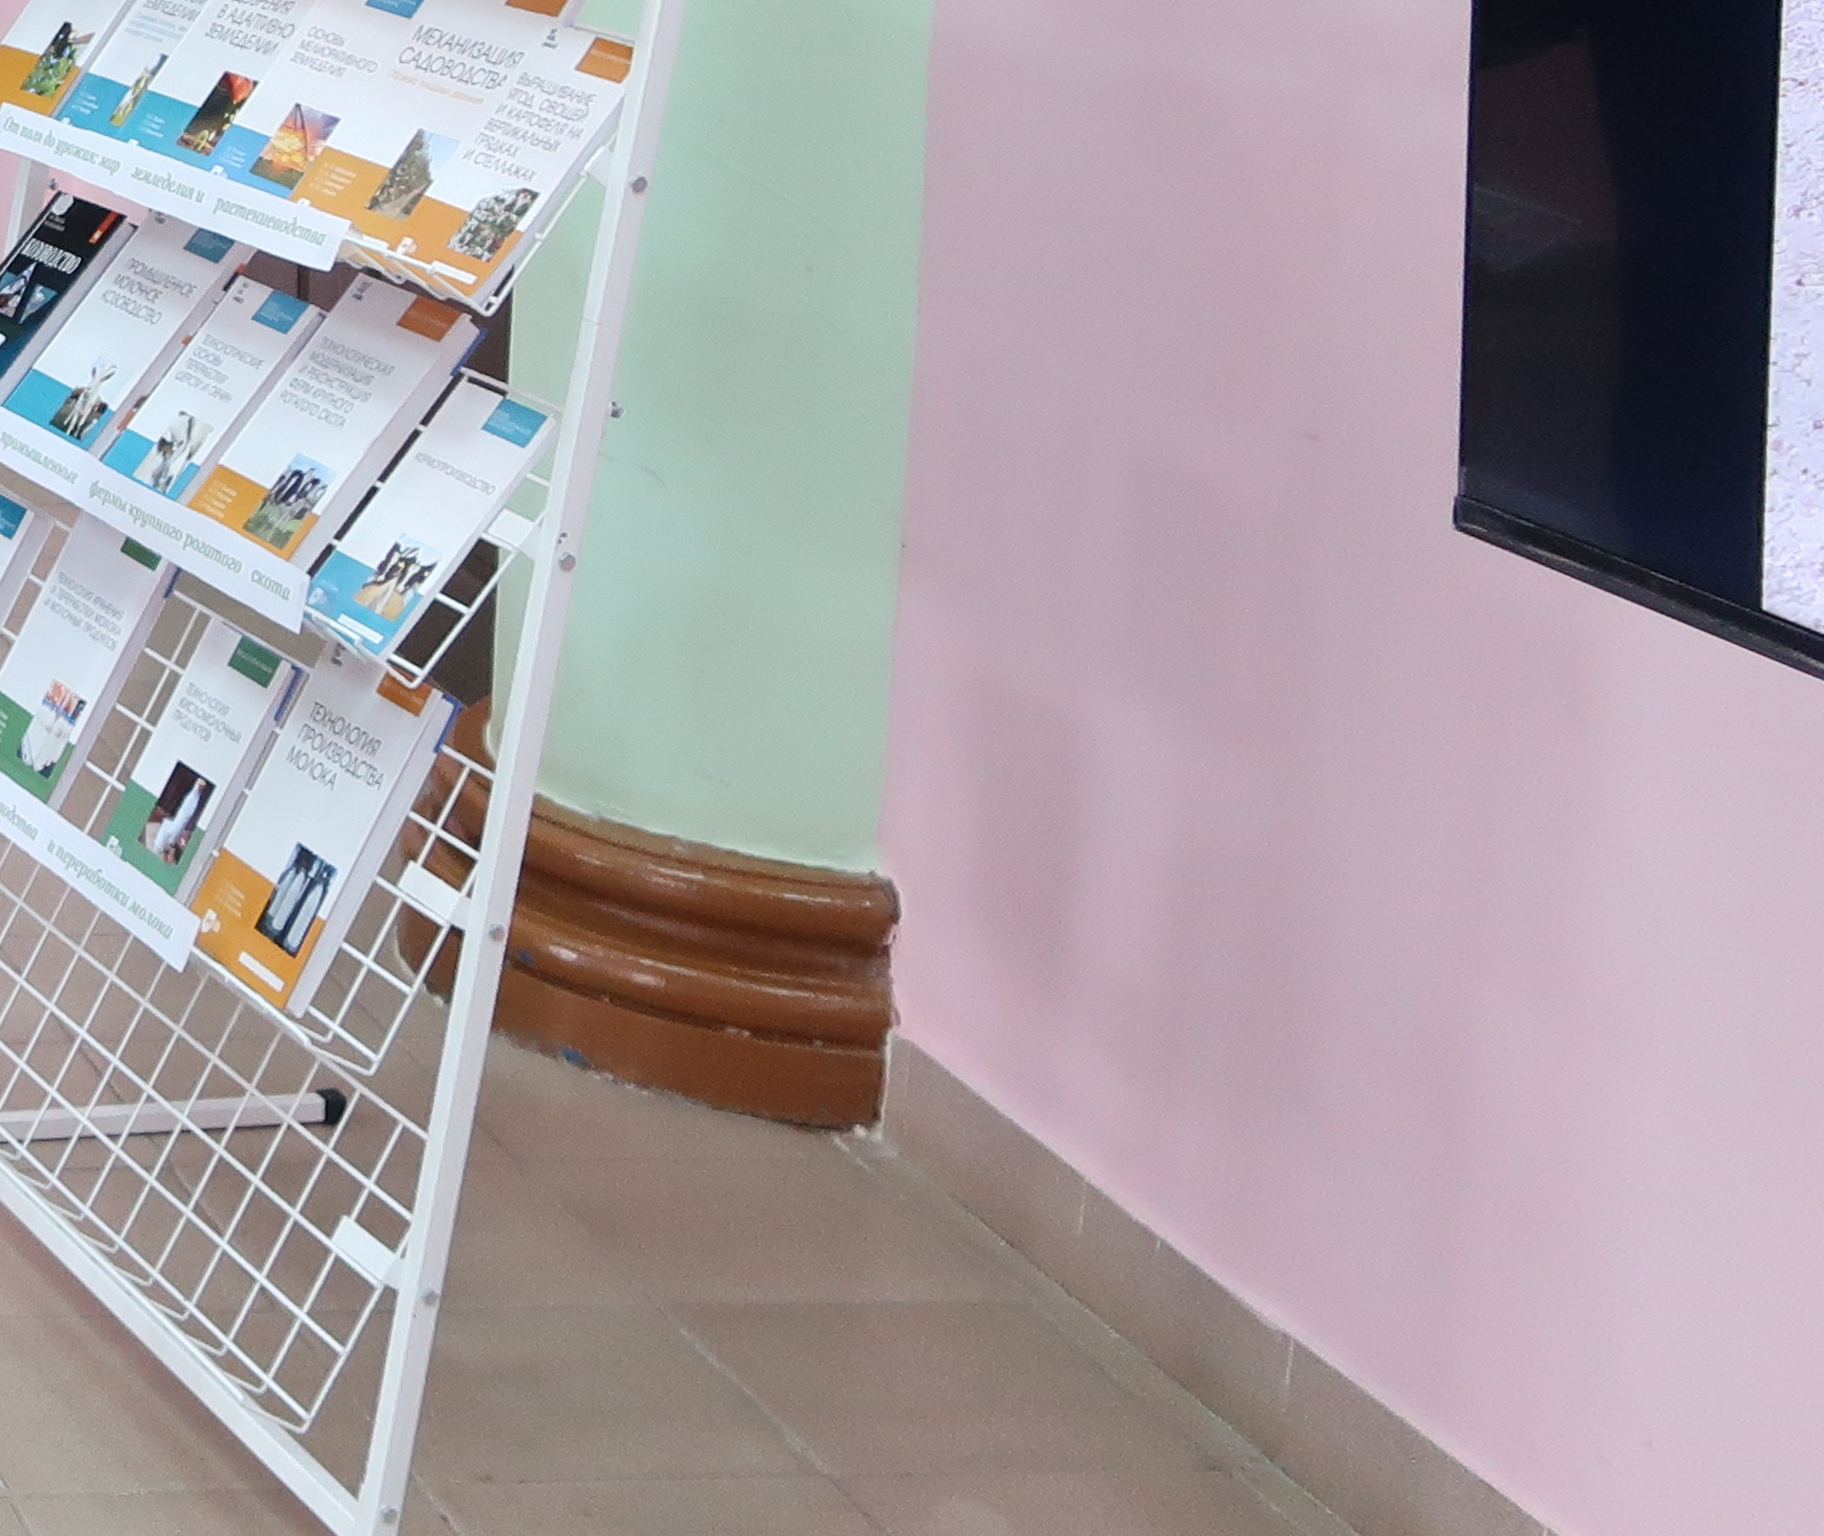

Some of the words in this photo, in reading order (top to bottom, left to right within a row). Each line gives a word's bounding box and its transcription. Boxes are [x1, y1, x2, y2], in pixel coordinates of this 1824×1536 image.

[204, 21, 281, 57] ЗЕМЛЕДЕЛИИ
[224, 5, 298, 40] АДАПТИВНО
[397, 46, 509, 91] САДОВОДСТВА
[411, 24, 526, 70] МЕХАНИЗАЦИЯ
[212, 197, 329, 247] растениеводства
[127, 502, 183, 546] крупного
[250, 569, 292, 604] скота
[309, 700, 383, 757] ТЕХНОЛОГИЯ
[284, 745, 339, 793] МОЛОКА
[297, 724, 386, 792] ПРОИЗВОДСТВА
[127, 896, 175, 943] молока
